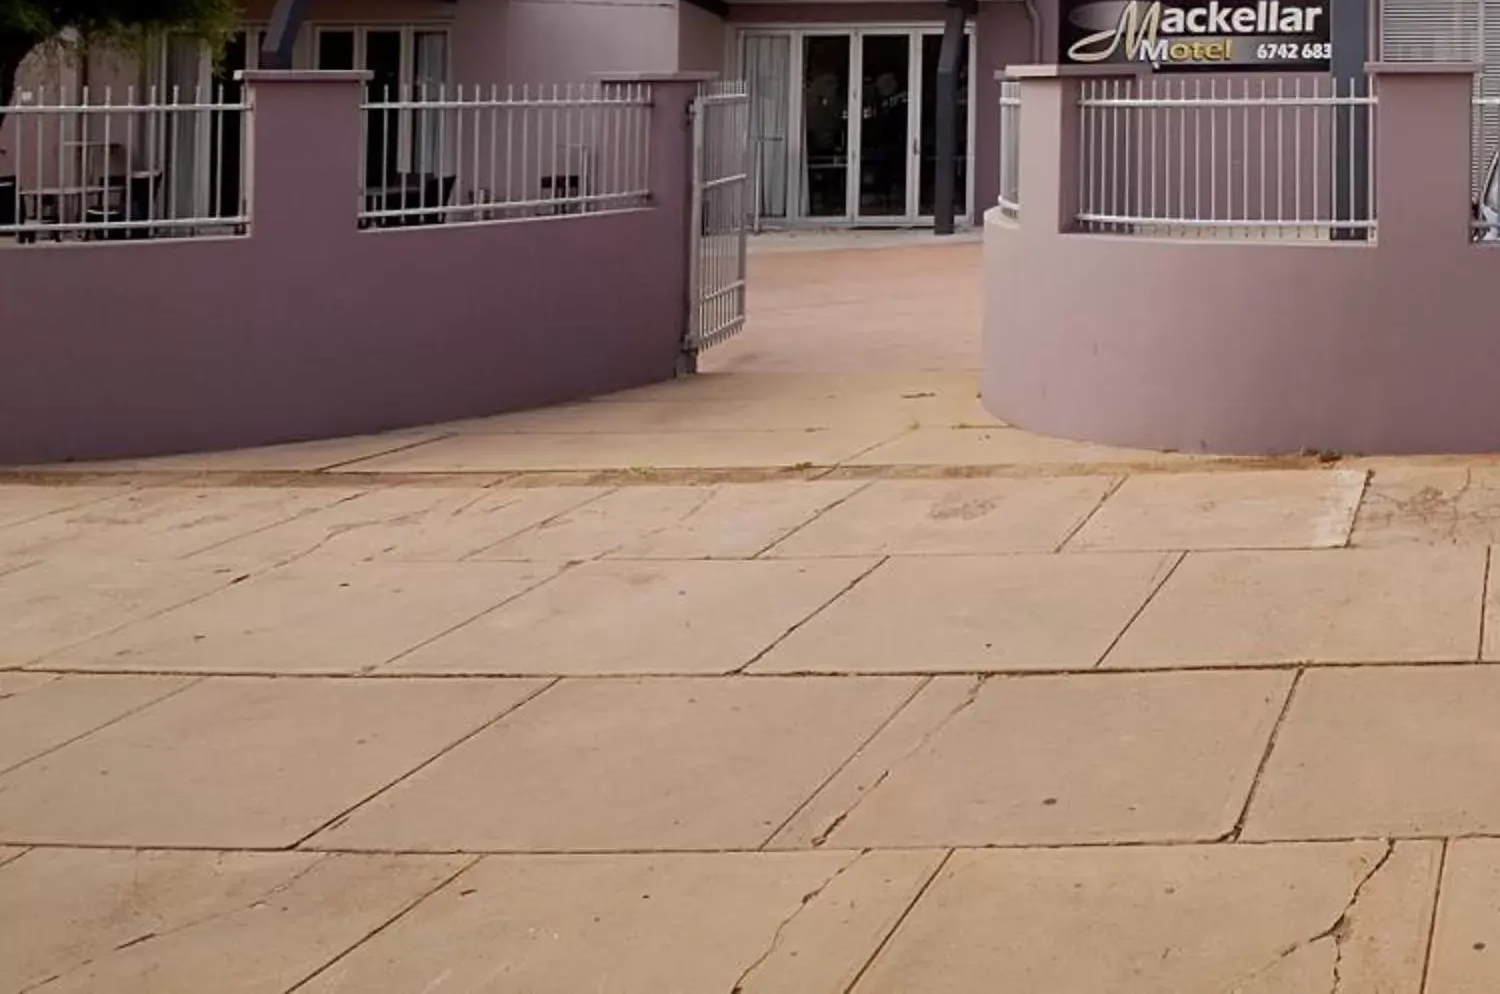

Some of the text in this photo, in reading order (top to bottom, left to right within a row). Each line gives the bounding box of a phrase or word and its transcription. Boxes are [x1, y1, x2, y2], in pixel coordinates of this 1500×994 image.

[1139, 38, 1332, 64] Motel 6742 683
